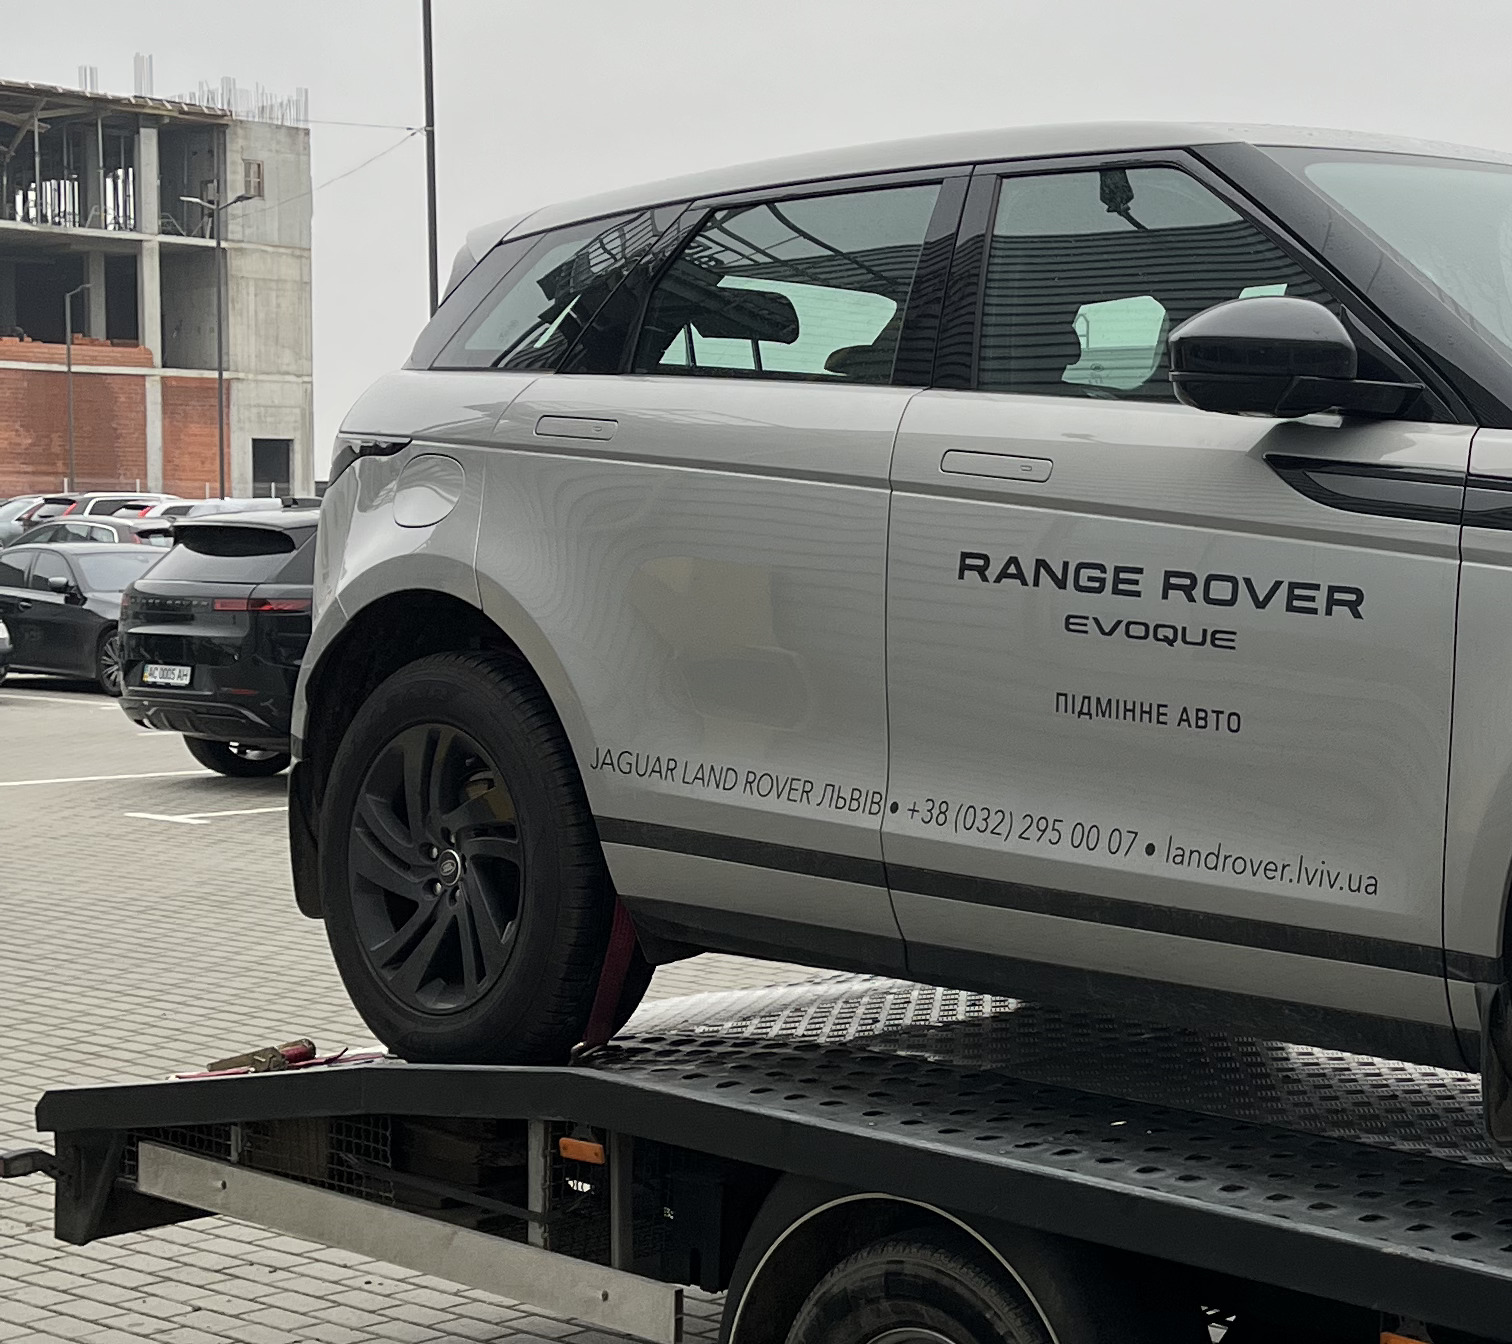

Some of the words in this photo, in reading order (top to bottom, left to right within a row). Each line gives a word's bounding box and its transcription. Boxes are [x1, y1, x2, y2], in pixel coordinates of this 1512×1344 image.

[957, 551, 1144, 598] RANGE
[1161, 569, 1364, 620] ROVER
[1064, 614, 1237, 650] EVOQUE
[1055, 691, 1169, 726] ПІДМІННЕ
[1176, 706, 1241, 734] АВТО
[590, 747, 678, 782] JAGUAR
[682, 760, 739, 790] LAND
[742, 770, 814, 805] ROVER
[816, 784, 883, 816] ЛЬВІВ
[907, 798, 949, 827] +38
[954, 803, 1014, 843] (032)
[1017, 813, 1065, 846] 295
[1070, 822, 1101, 852] 00
[1107, 828, 1139, 858] 07
[1165, 834, 1379, 896] landrover.lviv.ua
